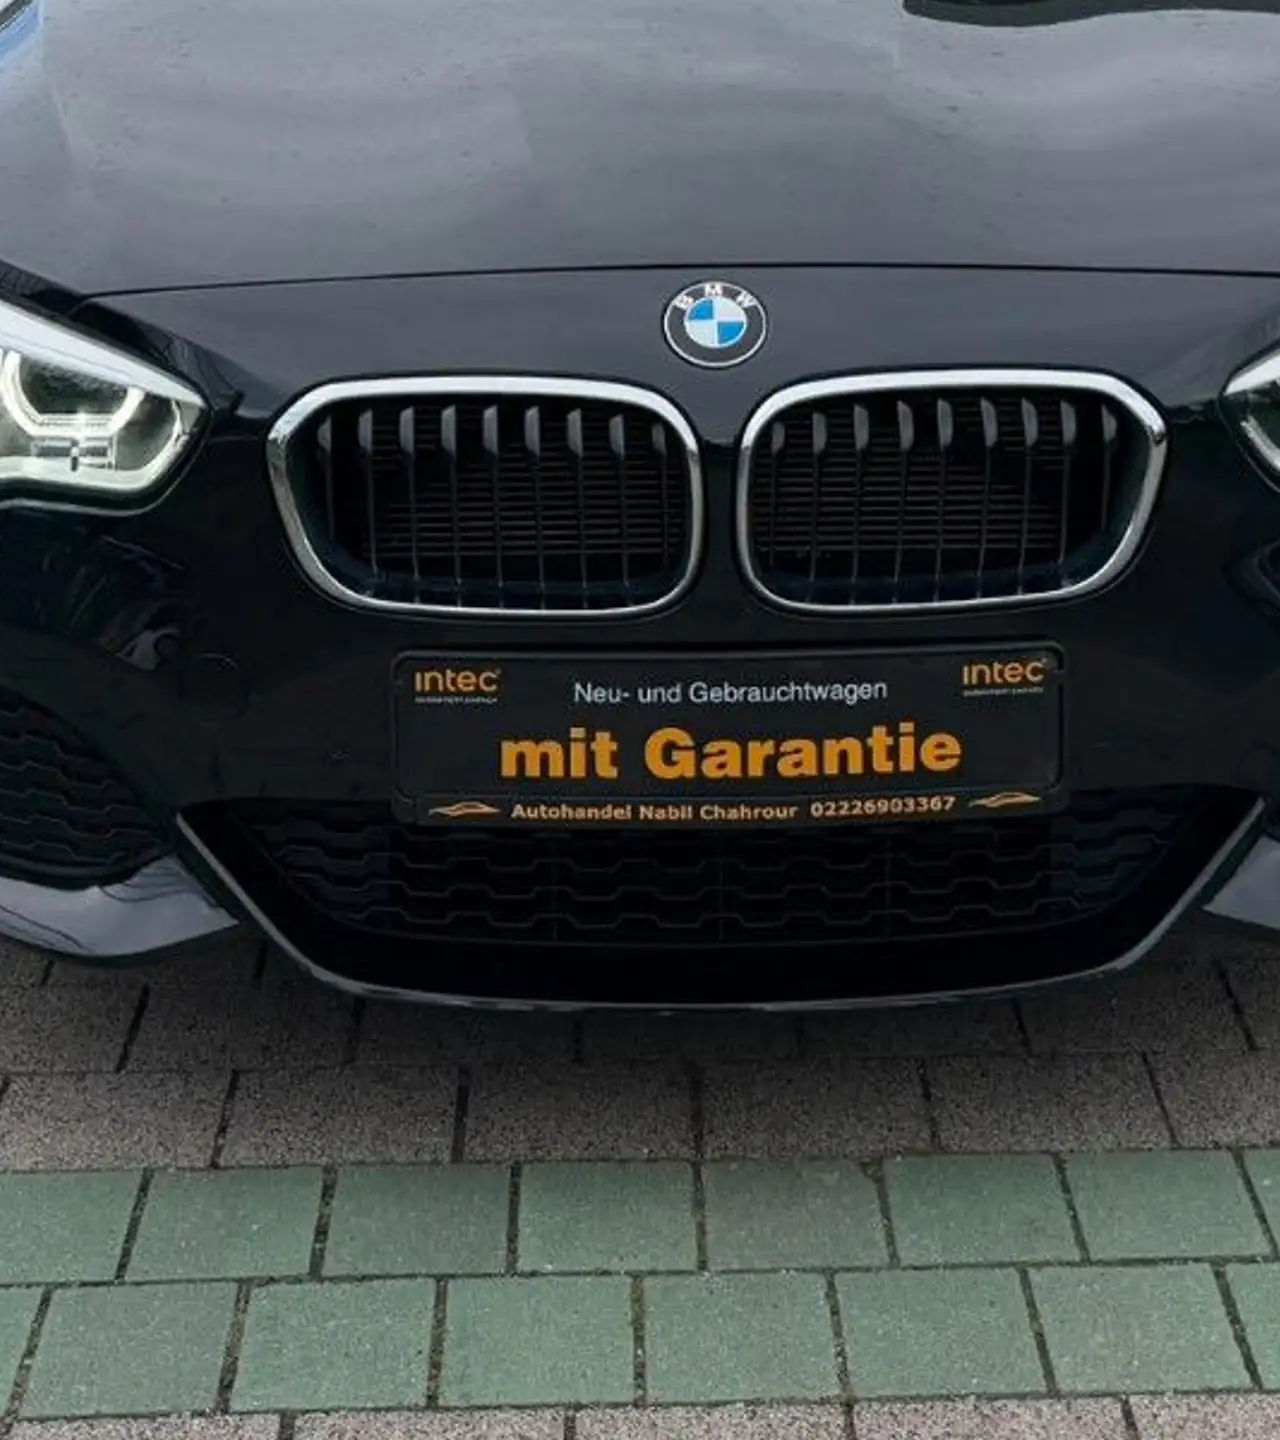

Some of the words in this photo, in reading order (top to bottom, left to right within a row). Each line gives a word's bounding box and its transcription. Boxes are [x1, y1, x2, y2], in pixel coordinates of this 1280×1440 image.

[415, 669, 497, 692] intec
[963, 662, 1044, 685] intec
[573, 681, 630, 704] Neu-
[638, 680, 681, 703] und
[689, 679, 887, 705] Gebrauchtwagen
[500, 727, 618, 779] mit
[645, 721, 962, 779] Garantie
[510, 801, 632, 820] Autohandel
[640, 800, 693, 820] Nabil
[700, 799, 798, 820] Chahrour
